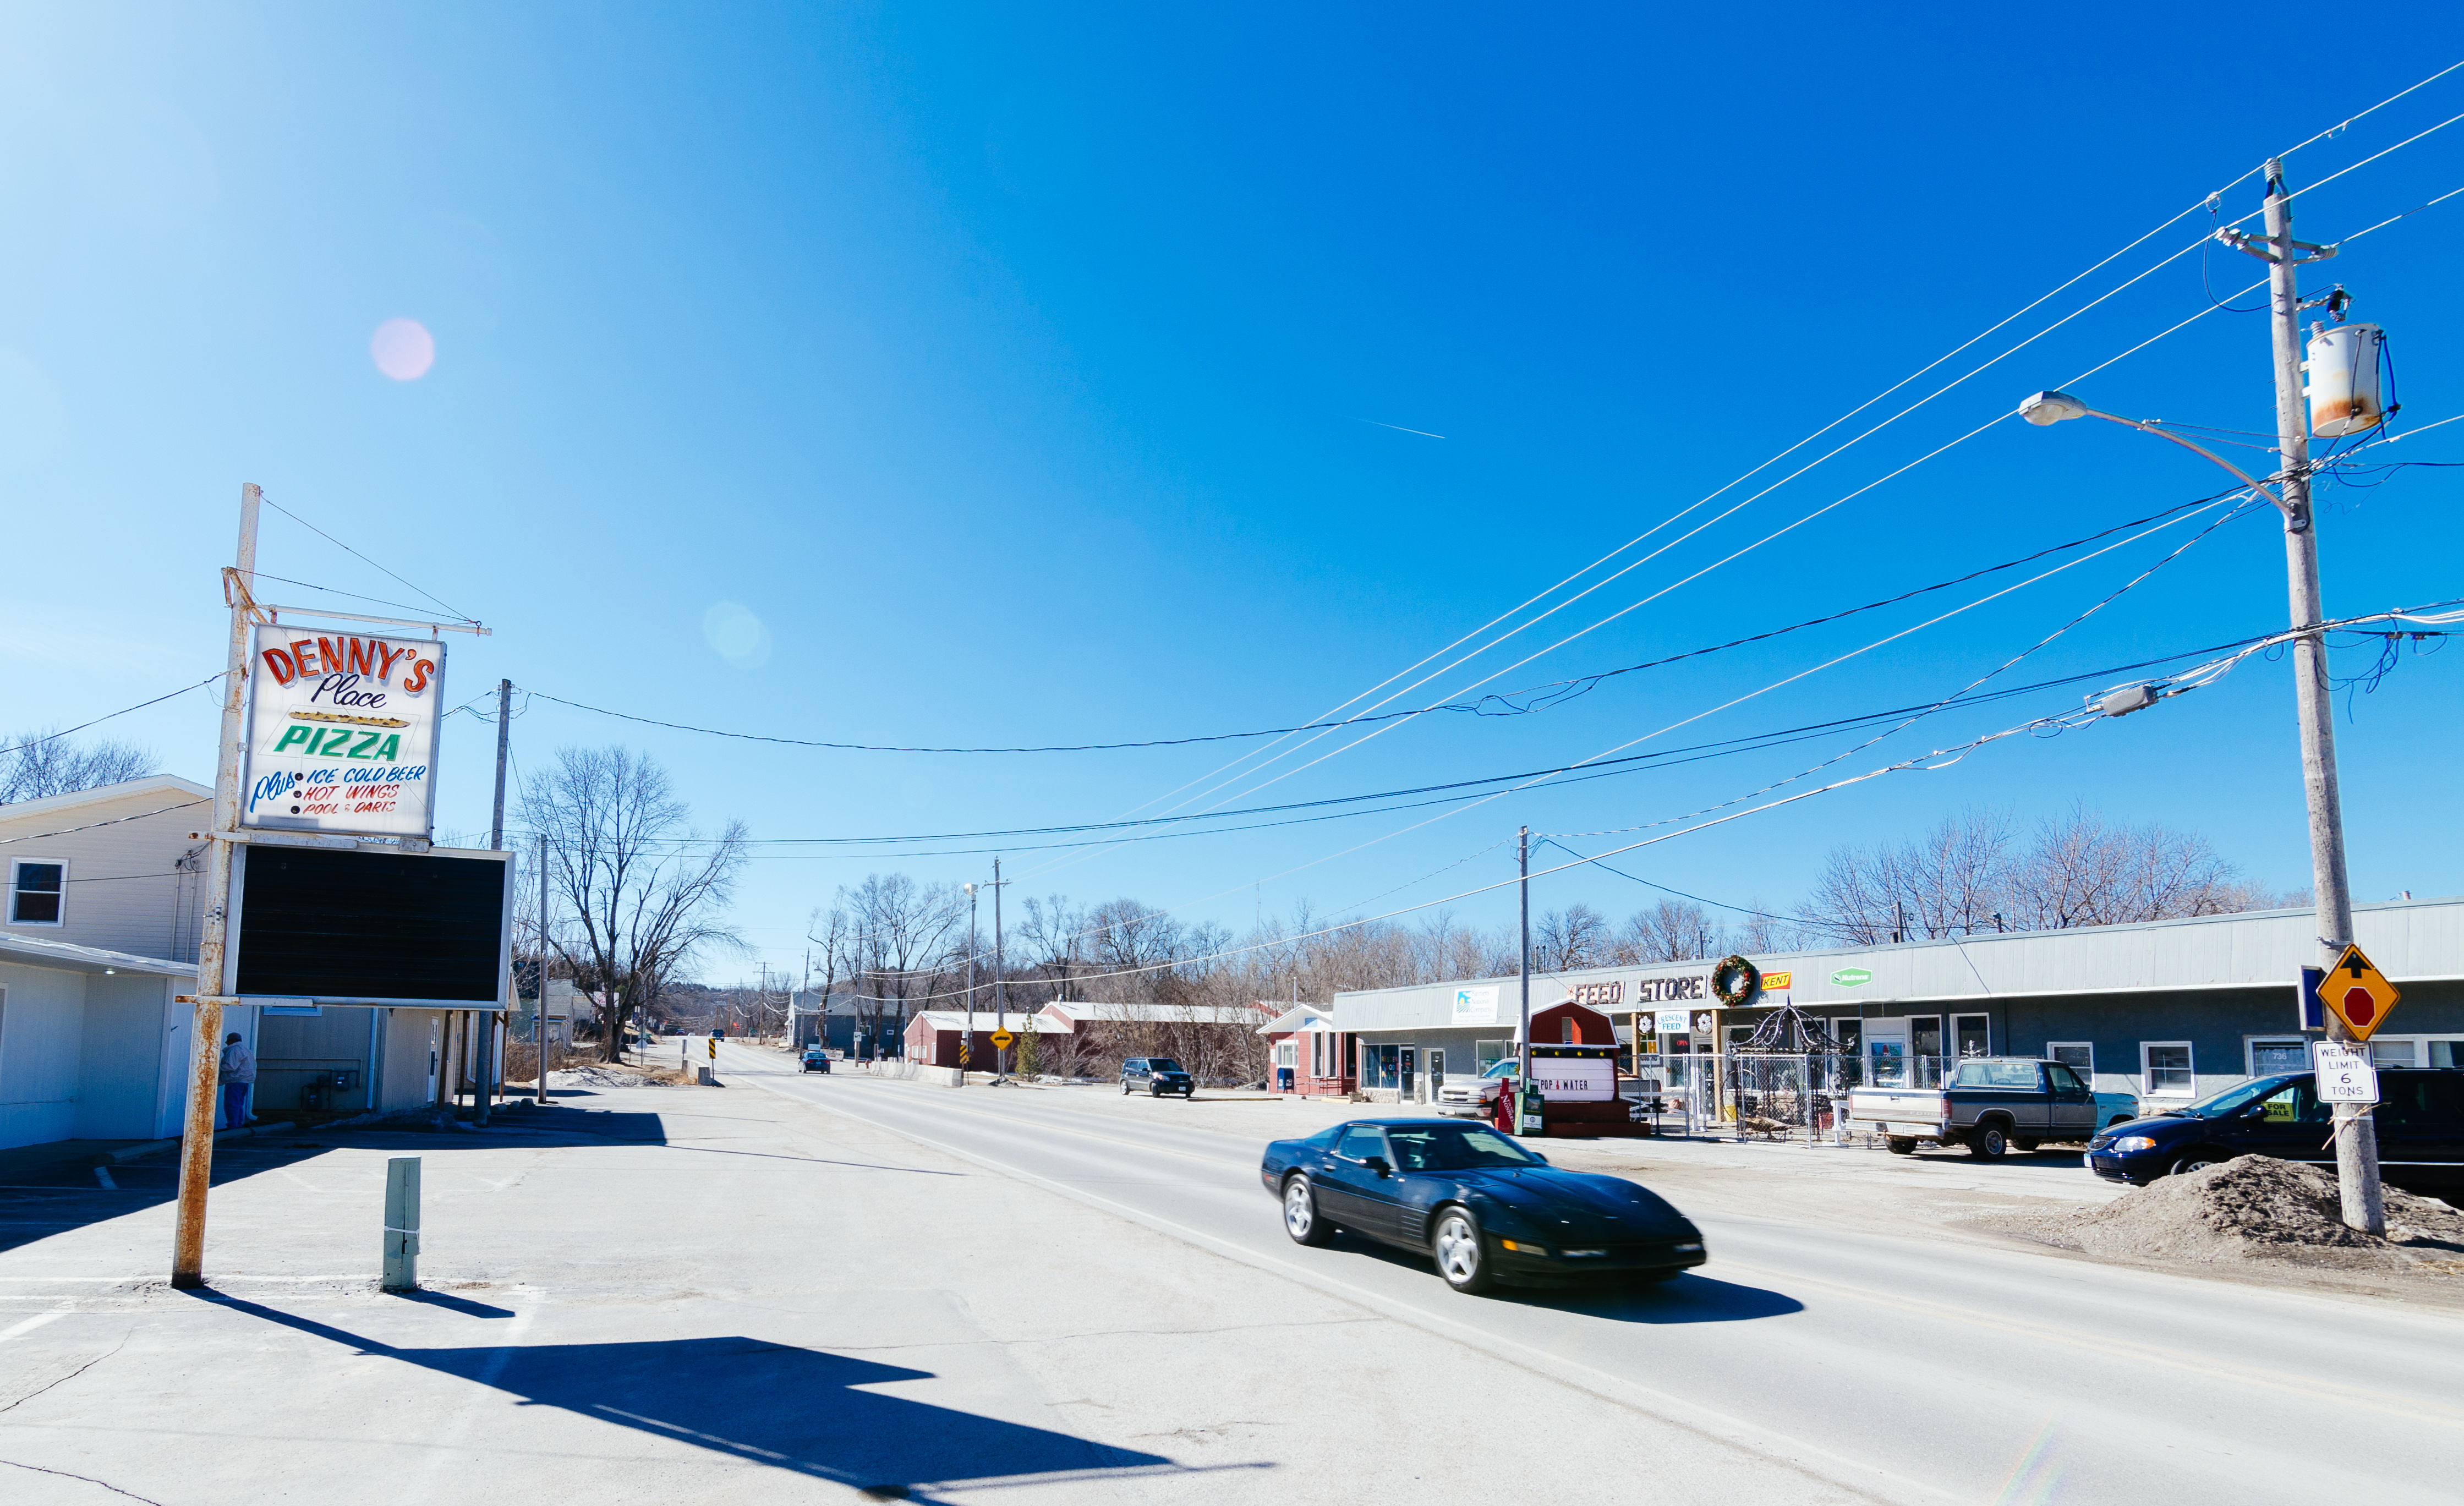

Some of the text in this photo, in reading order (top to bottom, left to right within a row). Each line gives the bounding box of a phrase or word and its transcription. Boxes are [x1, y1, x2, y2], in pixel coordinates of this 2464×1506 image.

[261, 637, 435, 693] DENNY'S
[310, 673, 387, 709] Place
[273, 725, 401, 762] PIZZA
[306, 765, 426, 784] ICE COLD BEER
[249, 771, 295, 813] plus
[303, 784, 400, 801] HOT WINGS
[303, 803, 338, 814] POOL
[354, 801, 396, 813] DARTS
[1763, 974, 1789, 987] KENT
[1575, 976, 1704, 1005] FEED STORE
[1657, 1014, 1687, 1025] CRESCENT
[2320, 1048, 2366, 1057] WEIGHT
[2329, 1061, 2359, 1069] LIMIT
[2341, 1073, 2351, 1083] 6
[1541, 1080, 1552, 1089] POP
[1563, 1080, 1587, 1090] WATER
[2331, 1087, 2364, 1095] TONS
